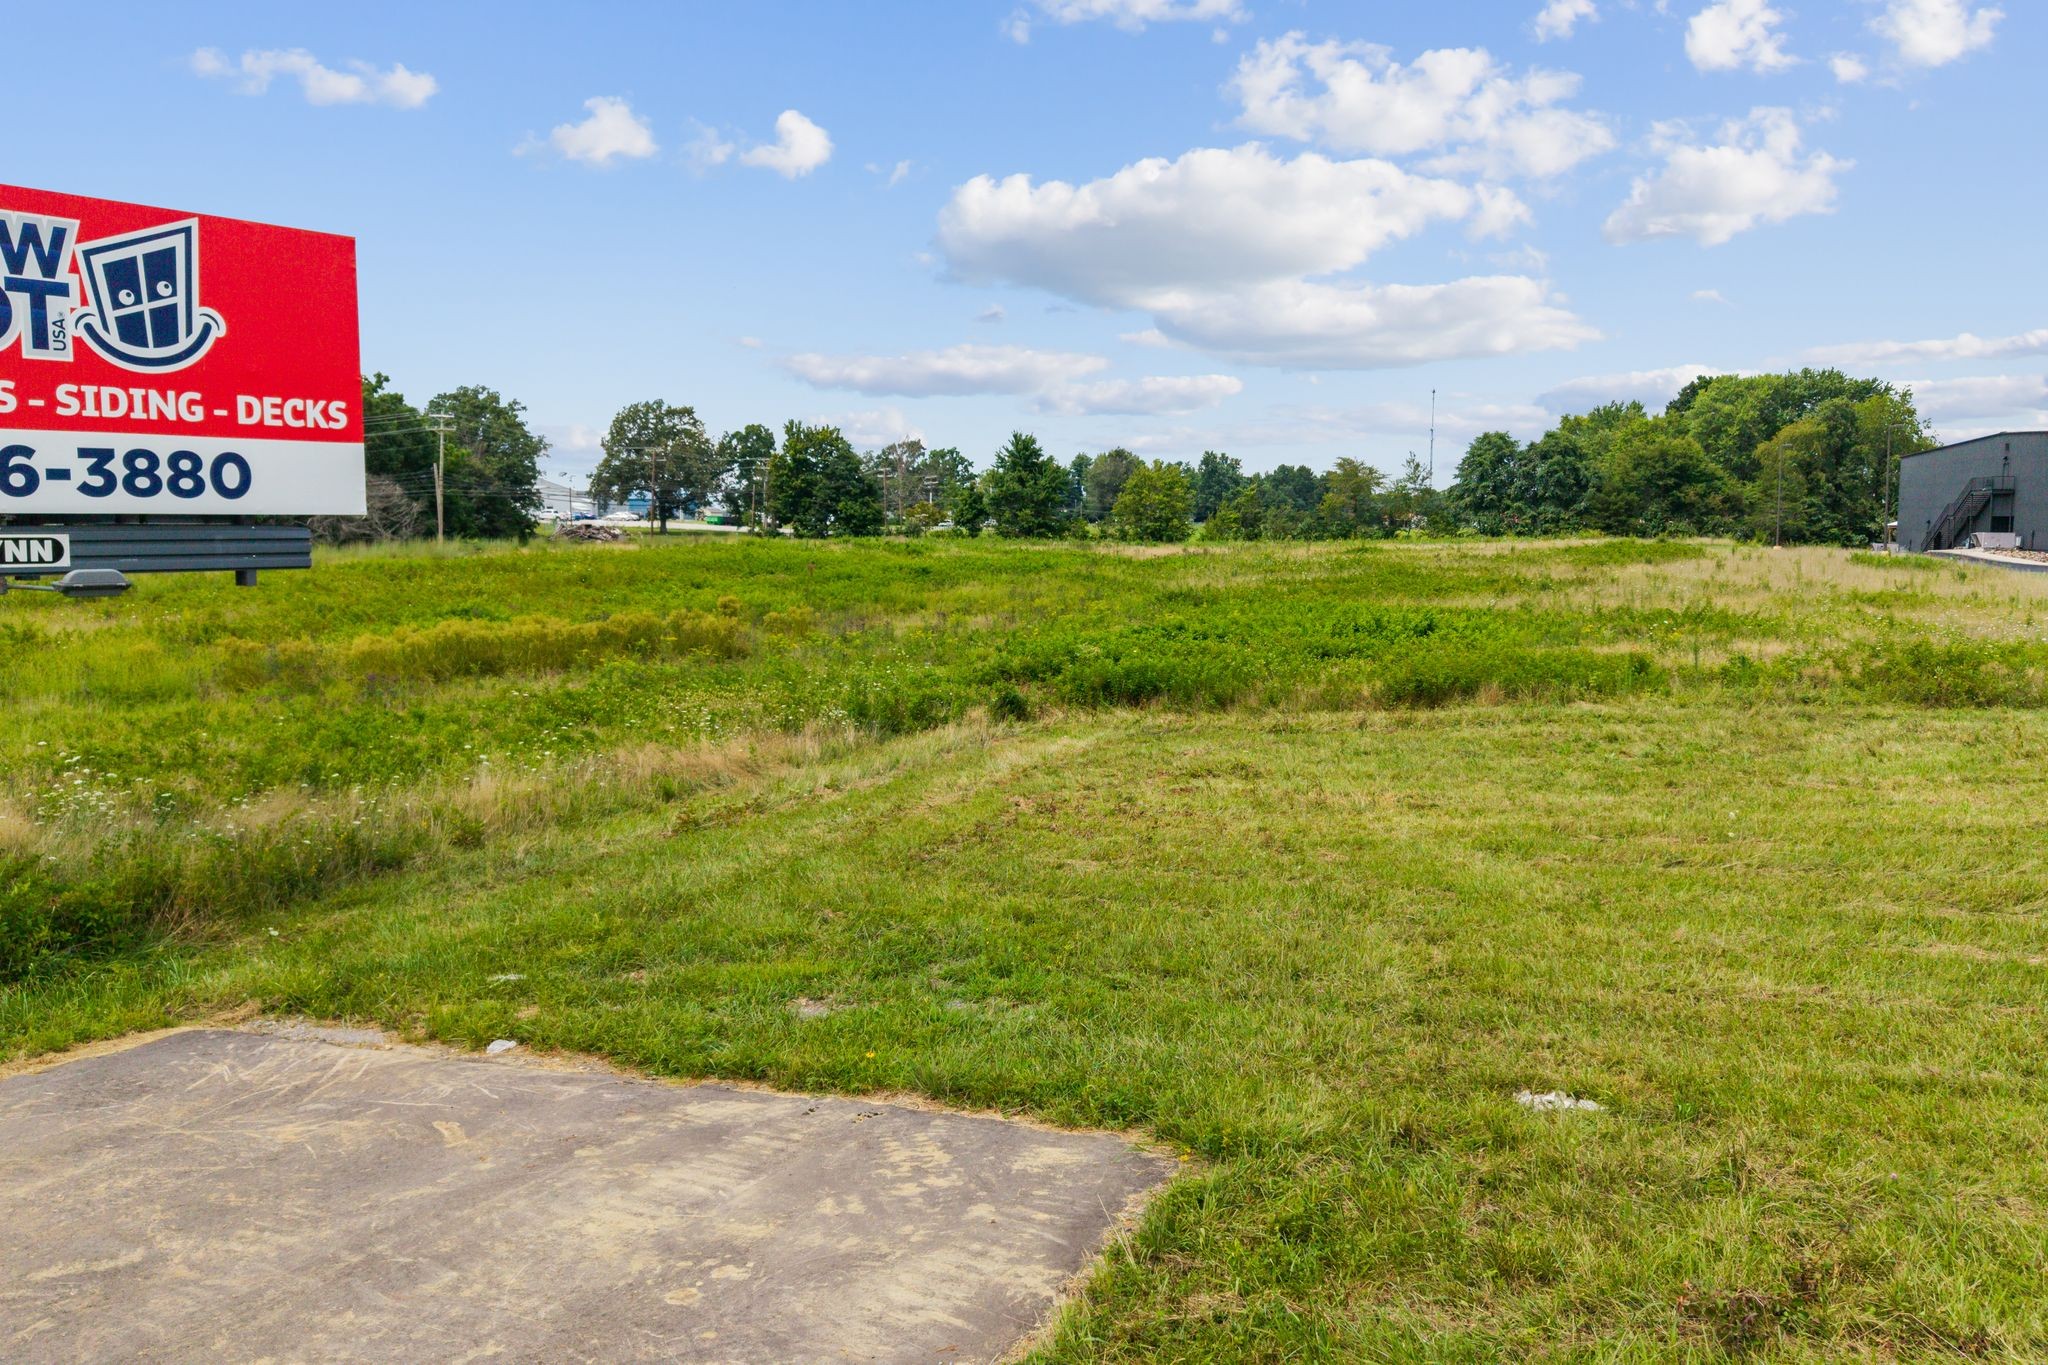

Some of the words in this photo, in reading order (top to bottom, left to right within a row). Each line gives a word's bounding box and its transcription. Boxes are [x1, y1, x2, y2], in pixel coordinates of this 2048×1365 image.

[0, 276, 70, 351] T
[53, 318, 66, 351] USA
[56, 383, 204, 422] SIDING
[236, 395, 348, 429] DECKS
[0, 444, 252, 499] 6-3880
[0, 539, 53, 562] NN
